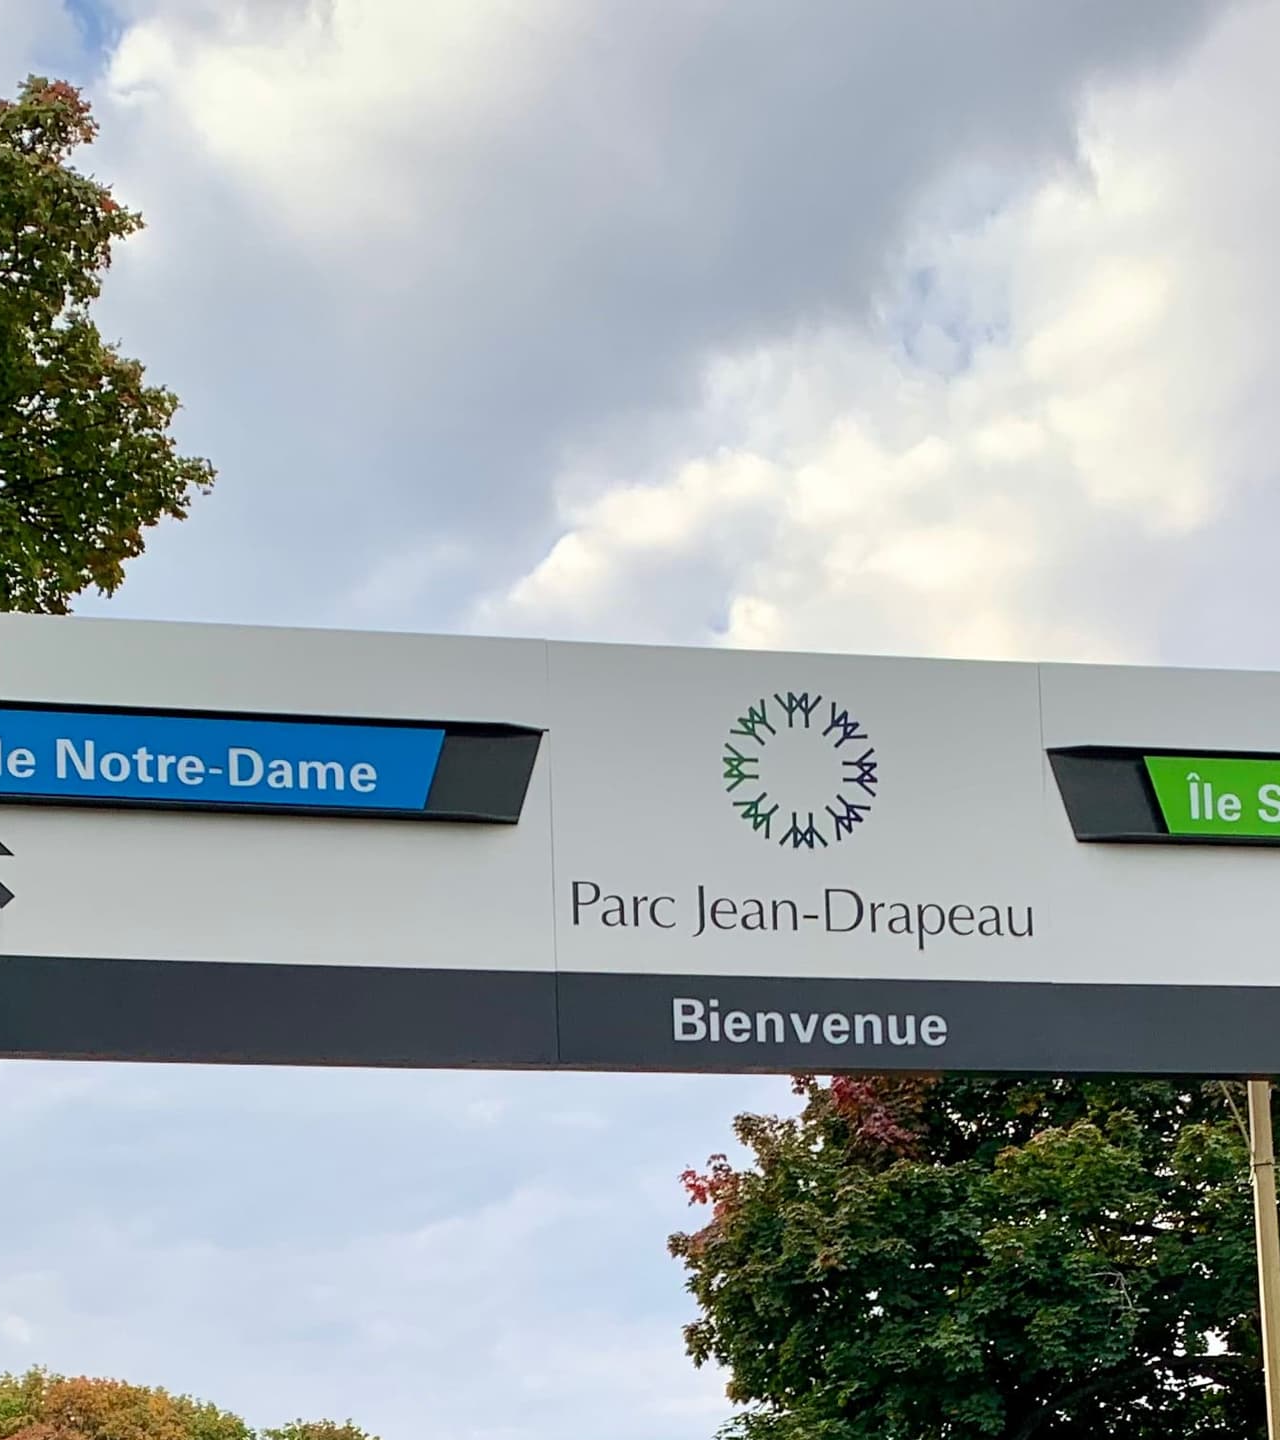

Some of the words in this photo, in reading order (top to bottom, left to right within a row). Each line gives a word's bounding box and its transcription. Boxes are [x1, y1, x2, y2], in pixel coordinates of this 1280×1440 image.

[55, 738, 378, 793] Notre-Dame
[1186, 772, 1241, 822] Île
[571, 880, 676, 929] Parc
[692, 885, 1035, 951] Jean-Drapeau
[672, 997, 948, 1047] Bienvenue
